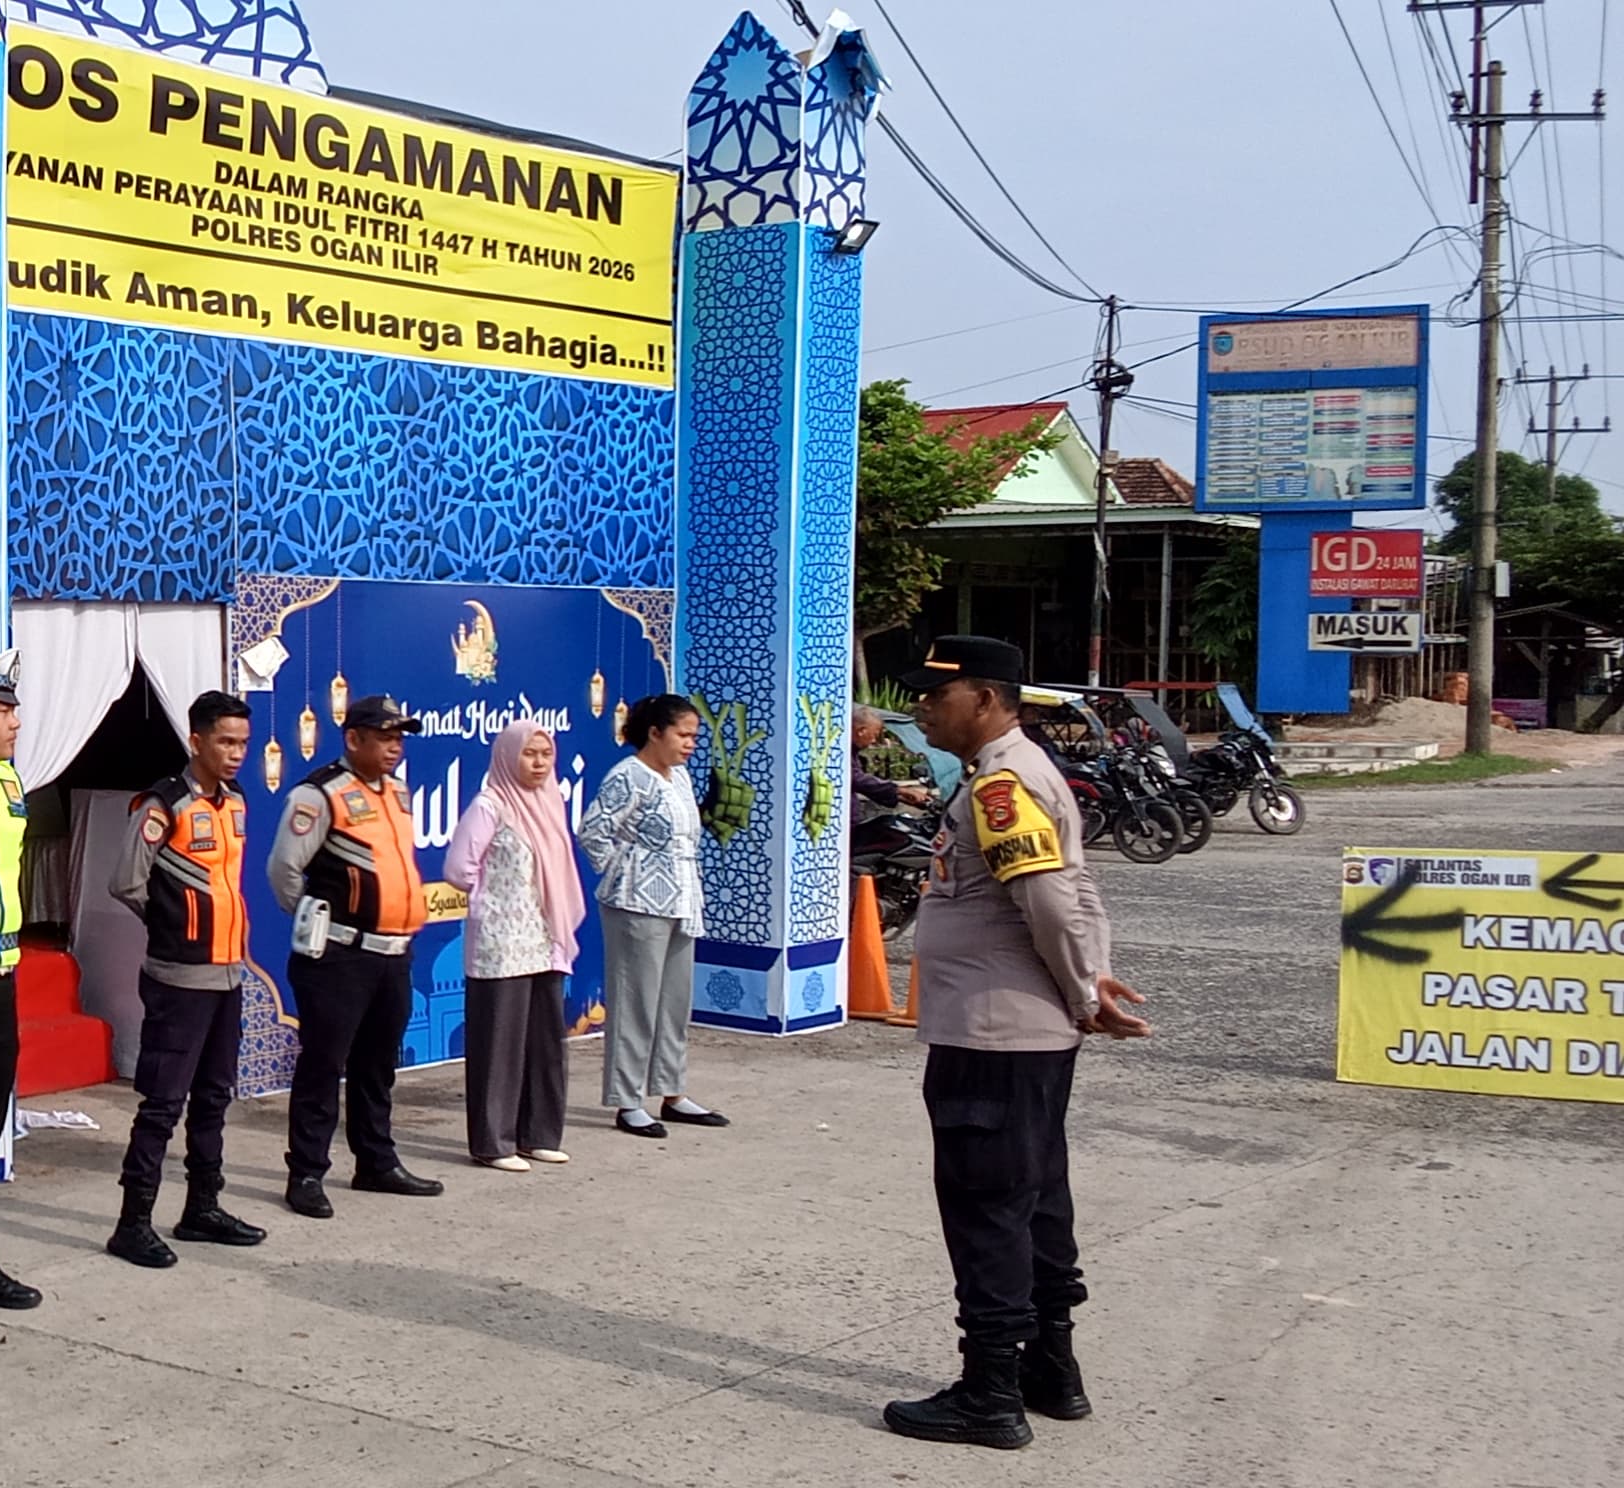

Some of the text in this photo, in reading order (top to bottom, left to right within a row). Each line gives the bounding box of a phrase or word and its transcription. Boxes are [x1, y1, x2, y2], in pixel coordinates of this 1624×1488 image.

[149, 73, 624, 227] PENGAMANAN
[214, 160, 424, 222] DALAM RANGKA
[114, 169, 264, 220] PERAYAAN
[274, 200, 336, 232] IDUL
[345, 213, 409, 245] FITRI
[418, 227, 474, 256] 1447
[481, 236, 498, 260] H
[505, 241, 582, 273] TAHUN
[588, 255, 636, 283] 2026
[191, 213, 439, 277] POLRES OGAN ILIR
[8, 258, 667, 373] udik Aman, Keluarga Bahagia...!!
[1311, 536, 1417, 572] IGD 24 JAM
[1317, 615, 1409, 637] MASUK
[1403, 858, 1483, 873] SATLANTAS
[1406, 871, 1532, 888] OLRES OGAN ILIR
[1422, 971, 1589, 1015] PASAR
[1385, 1030, 1553, 1073] JALAN
